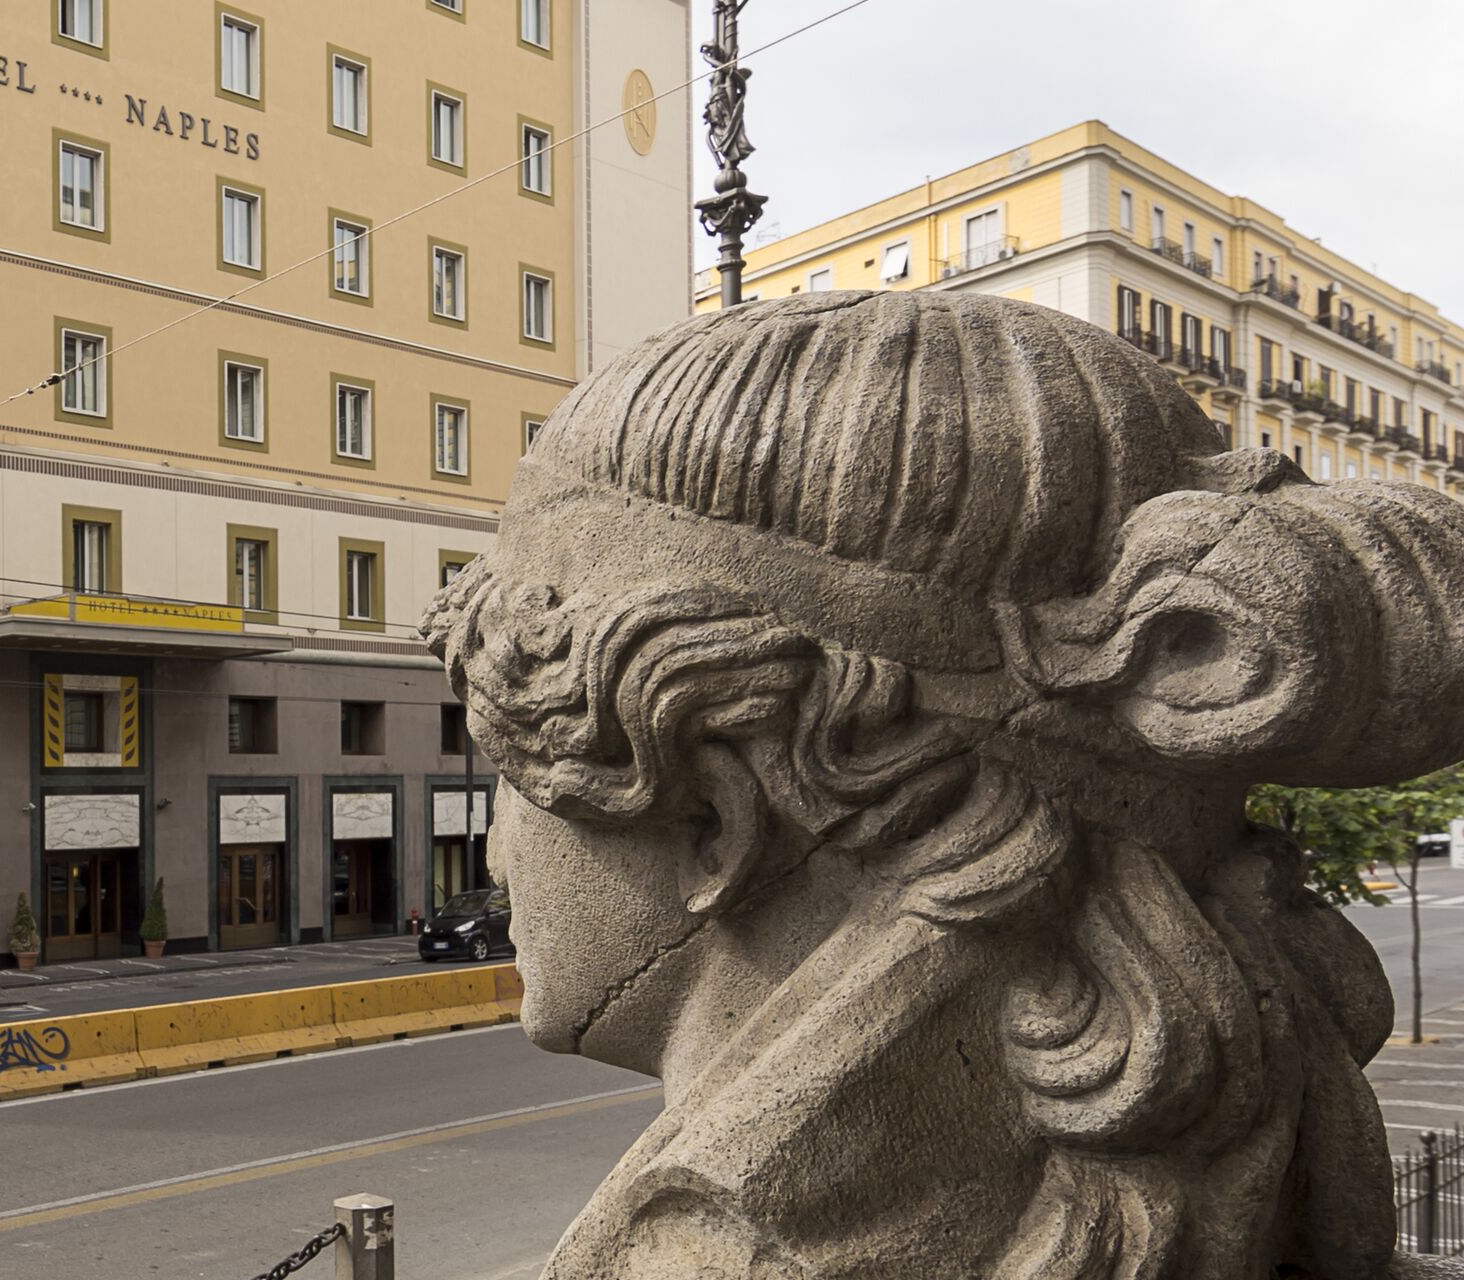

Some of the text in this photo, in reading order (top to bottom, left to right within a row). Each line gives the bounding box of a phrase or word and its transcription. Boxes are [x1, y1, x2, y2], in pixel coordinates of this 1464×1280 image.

[124, 93, 261, 161] NAPLES
[88, 600, 233, 621] HOTEL NAPLES
